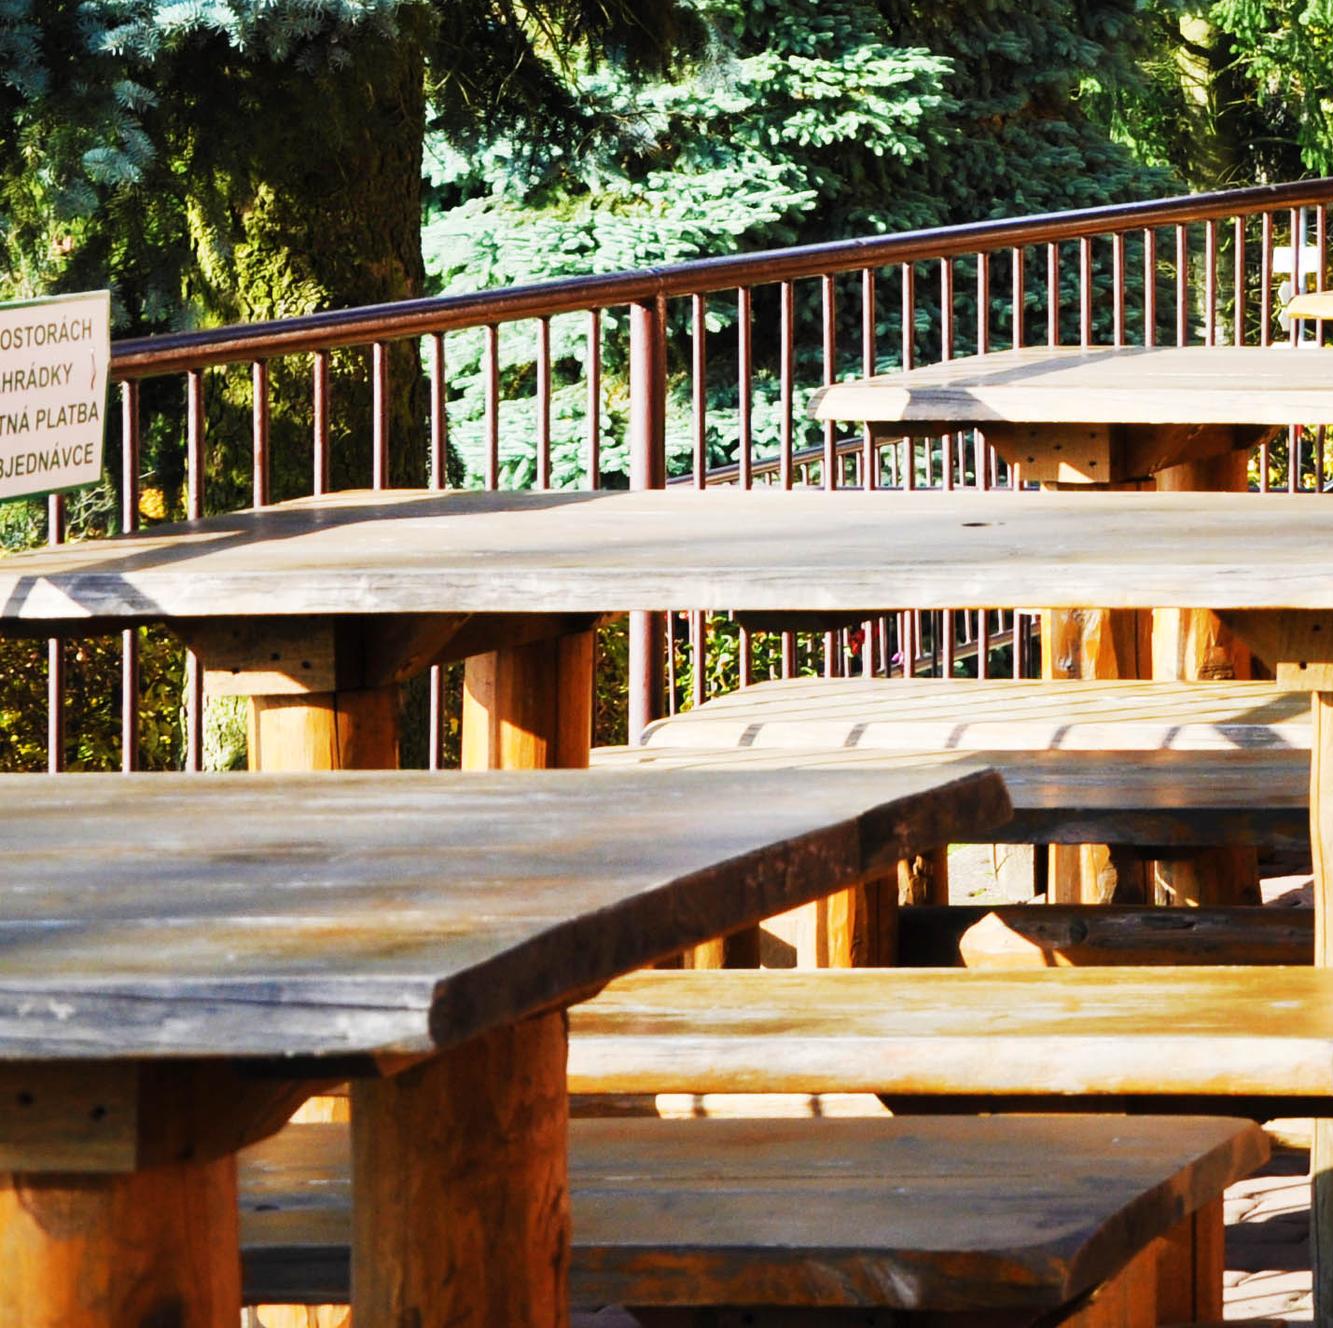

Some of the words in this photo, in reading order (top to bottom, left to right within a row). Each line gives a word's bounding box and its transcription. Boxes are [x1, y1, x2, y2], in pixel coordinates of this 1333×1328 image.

[0, 315, 92, 351] OSTORÁCH
[0, 362, 73, 393] HRÁDKY
[36, 401, 99, 431] PLATBA
